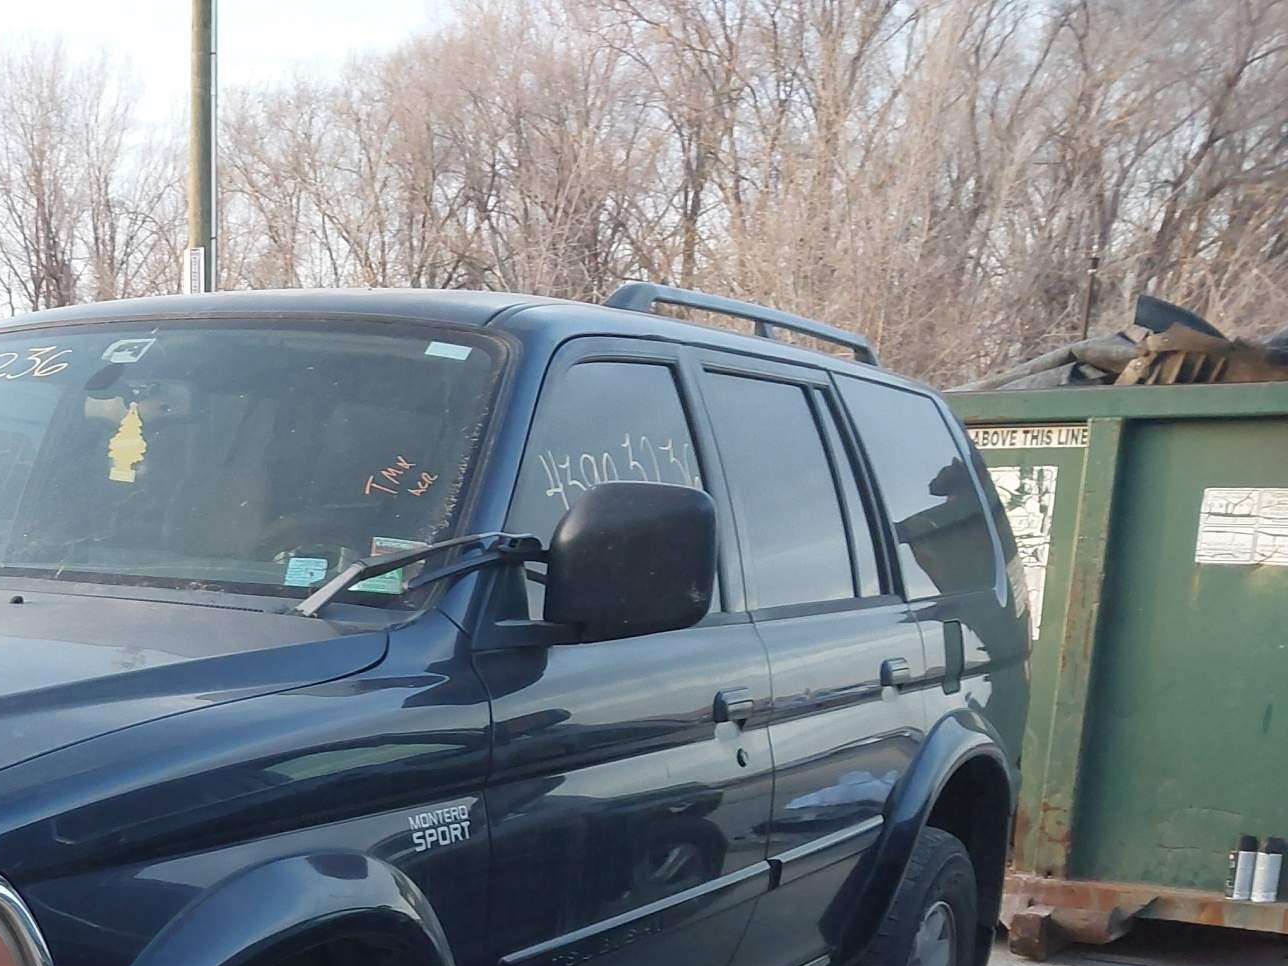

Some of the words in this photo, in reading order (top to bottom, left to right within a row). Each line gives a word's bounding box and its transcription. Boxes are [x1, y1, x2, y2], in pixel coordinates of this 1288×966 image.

[1022, 429, 1054, 446] THIS
[1057, 428, 1089, 446] LINE
[407, 805, 469, 831] MONTERO
[412, 820, 471, 852] SPORT
